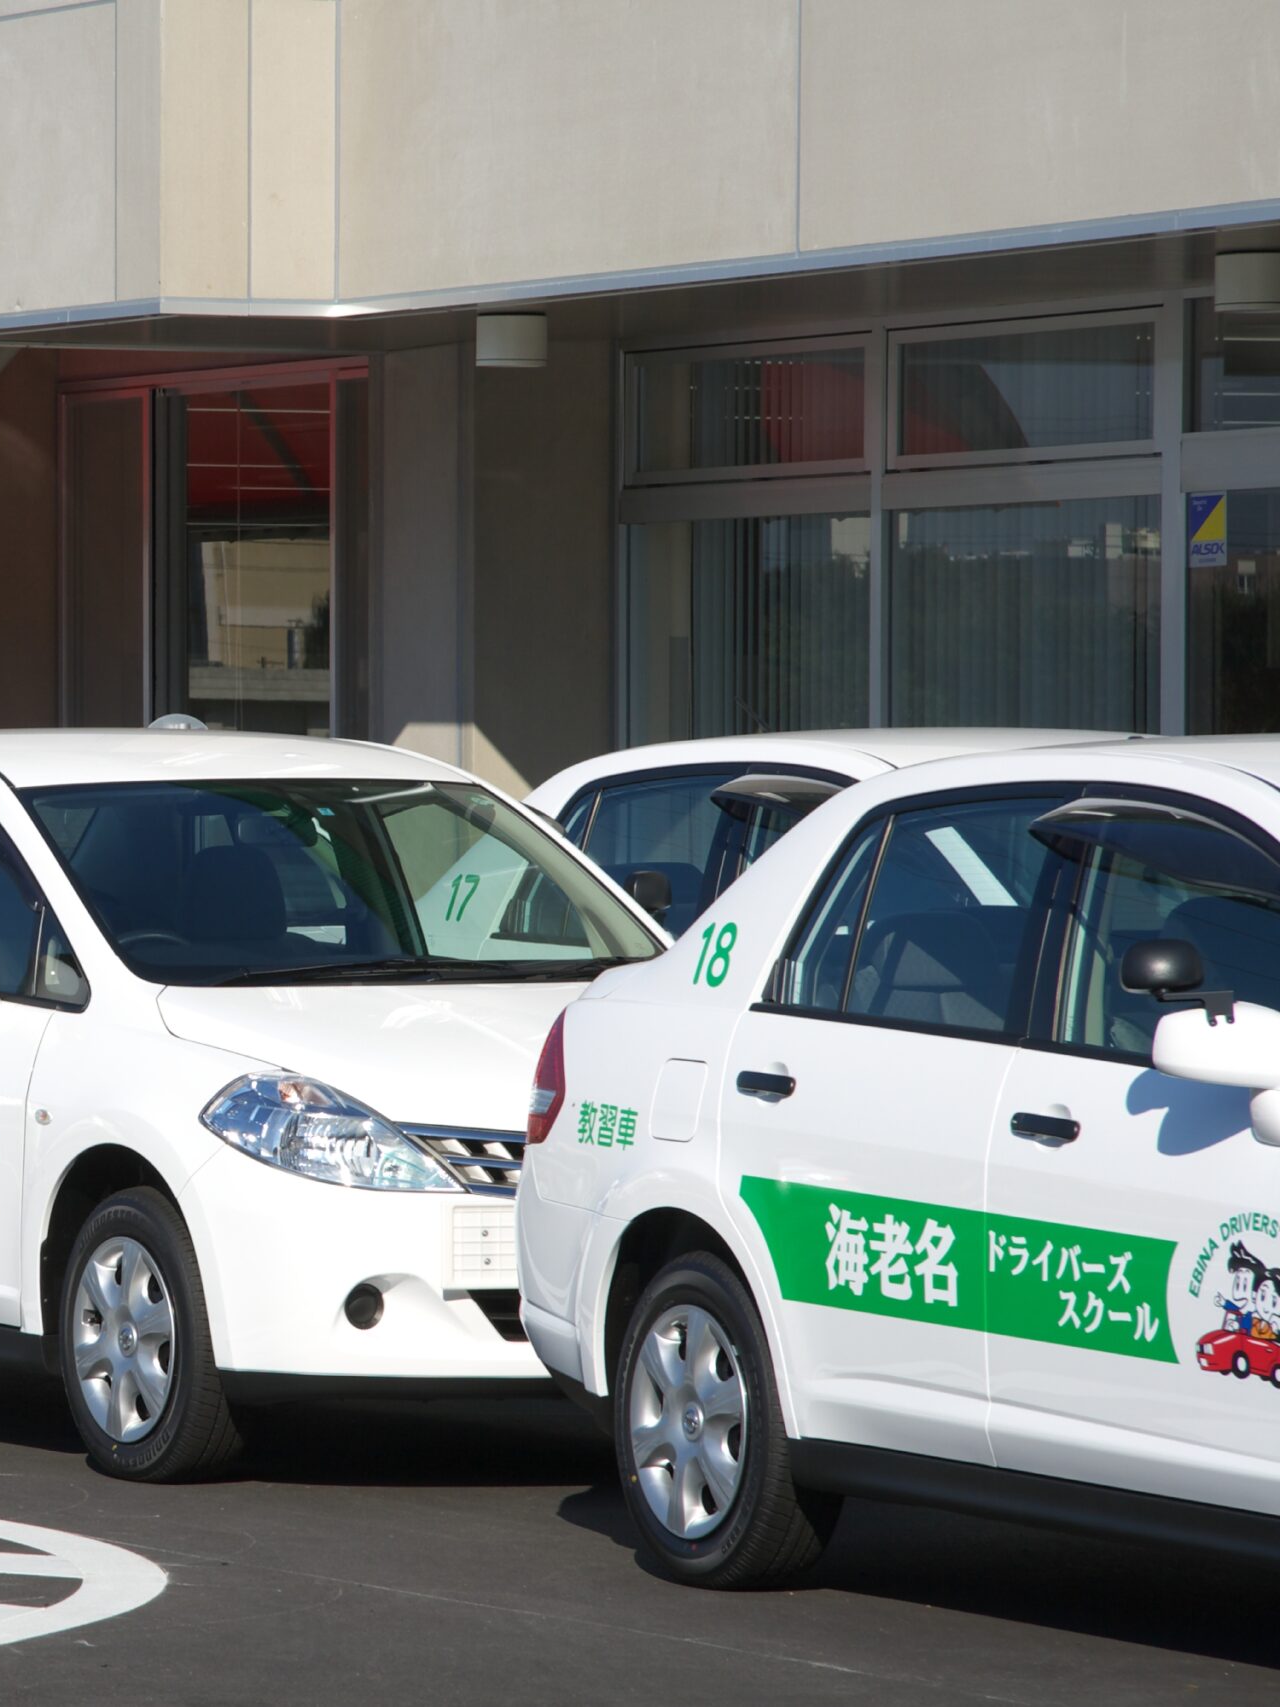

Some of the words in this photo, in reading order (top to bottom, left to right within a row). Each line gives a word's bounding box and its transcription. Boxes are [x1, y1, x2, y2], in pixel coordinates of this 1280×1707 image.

[445, 873, 480, 922] 17
[693, 922, 737, 987] 18
[577, 1100, 639, 1150] 教習車
[824, 1203, 958, 1307] 海老名
[988, 1230, 1132, 1294] ドライバーズ
[1188, 1237, 1220, 1299] EBINA
[1057, 1290, 1159, 1343] スクール
